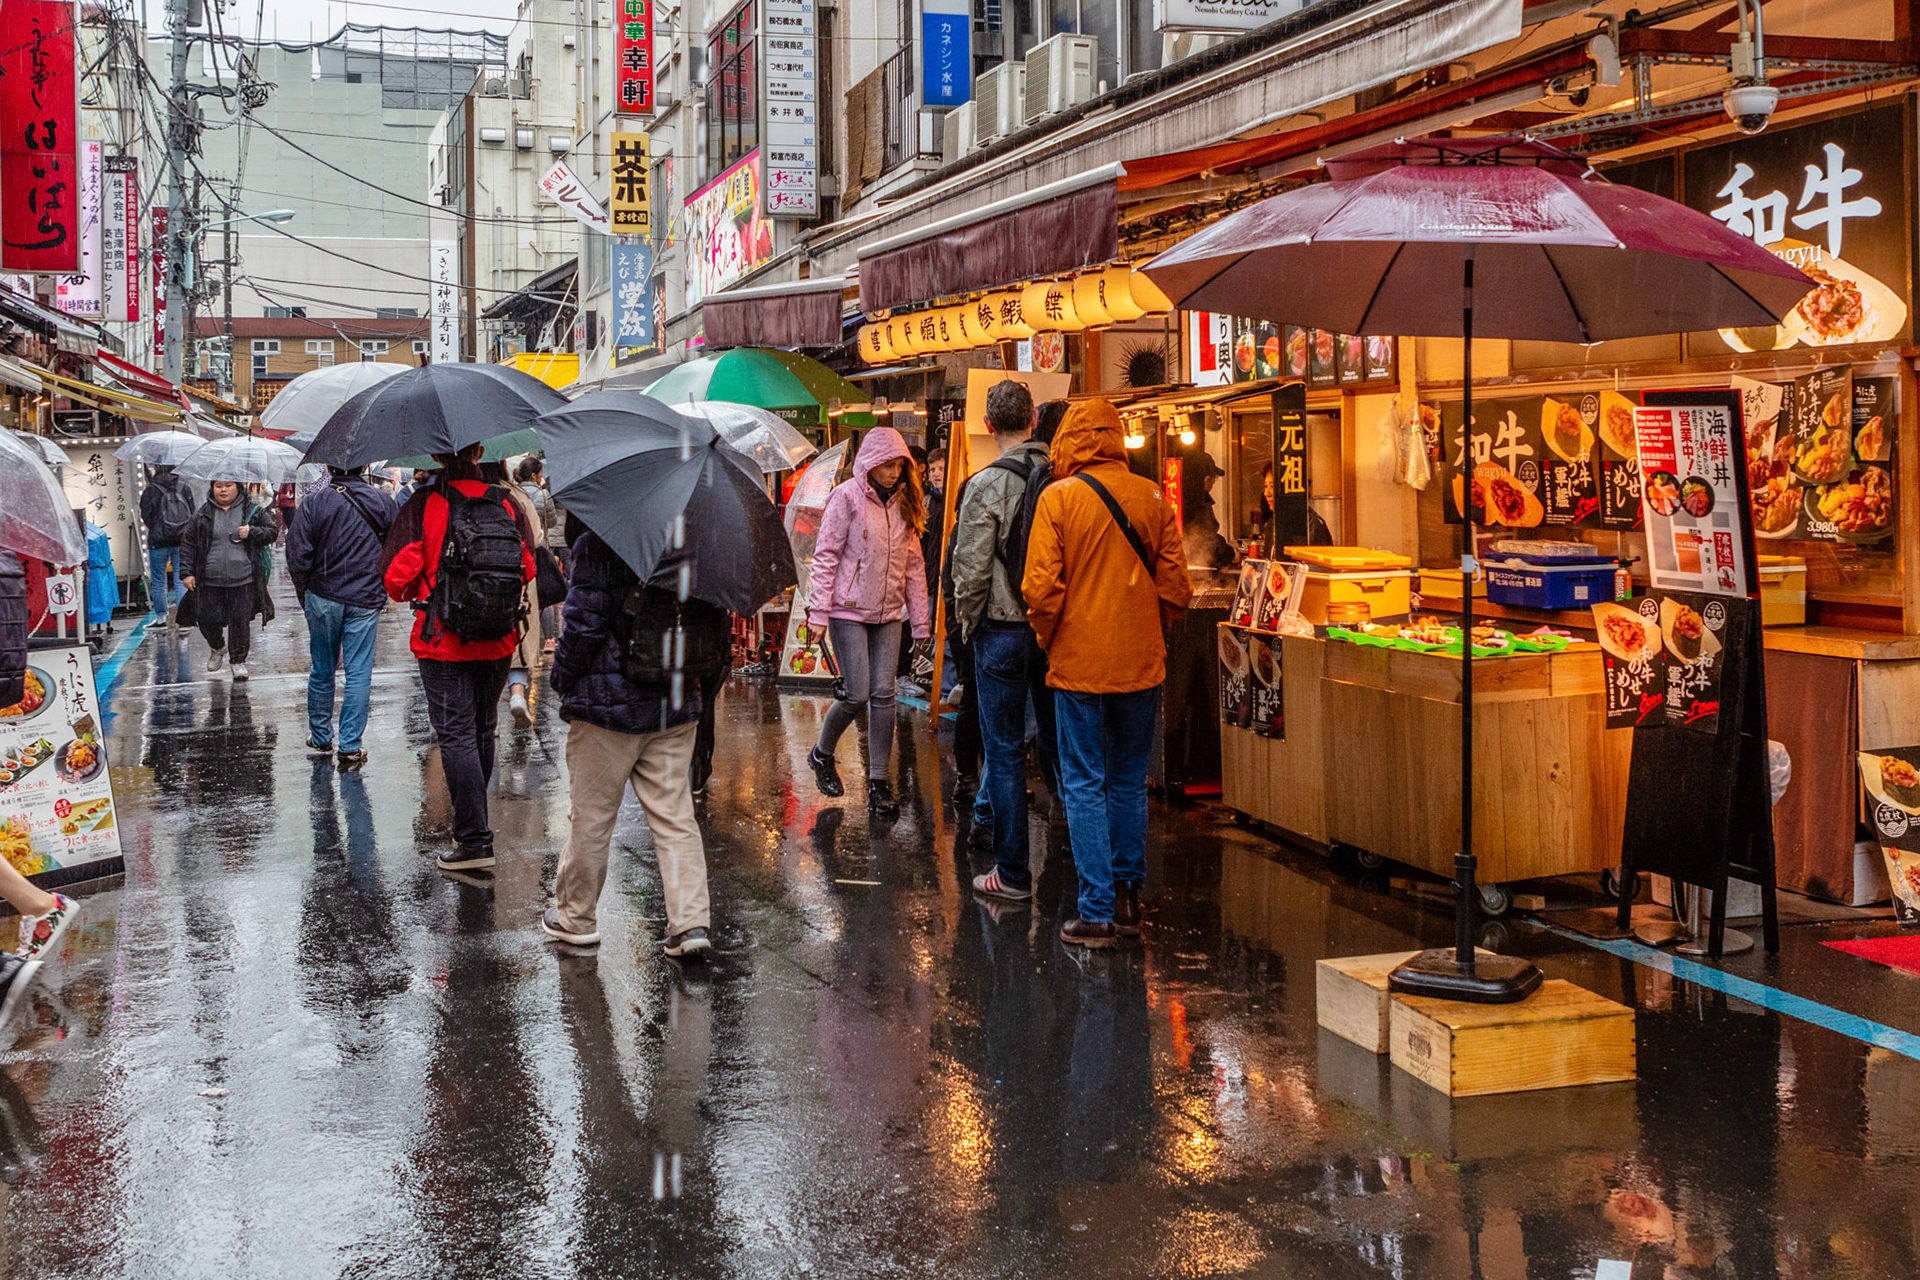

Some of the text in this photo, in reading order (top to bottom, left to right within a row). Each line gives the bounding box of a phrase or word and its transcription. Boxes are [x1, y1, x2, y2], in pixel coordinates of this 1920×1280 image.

[1220, 8, 1243, 16] Cutlery
[941, 22, 953, 97] カネシン水産
[613, 140, 648, 203] 茶
[113, 178, 124, 221] 株式会社
[1710, 142, 1882, 261] 和牛
[618, 253, 630, 279] えび
[634, 252, 646, 280] 冷凍品
[57, 299, 101, 312] 24時間営業
[1279, 414, 1305, 494] 元祖
[1453, 410, 1534, 478] 和牛
[1706, 410, 1731, 488] 海鮮丼
[1476, 467, 1507, 481] wagyu
[1613, 465, 1627, 508] めし
[1807, 521, 1839, 533] 3,980円
[66, 652, 90, 715] うに虎
[1628, 657, 1643, 695] のせ
[1640, 645, 1656, 684] 和牛
[1681, 659, 1695, 699] うに
[1695, 650, 1714, 691] 和牛
[1616, 667, 1630, 707] めし
